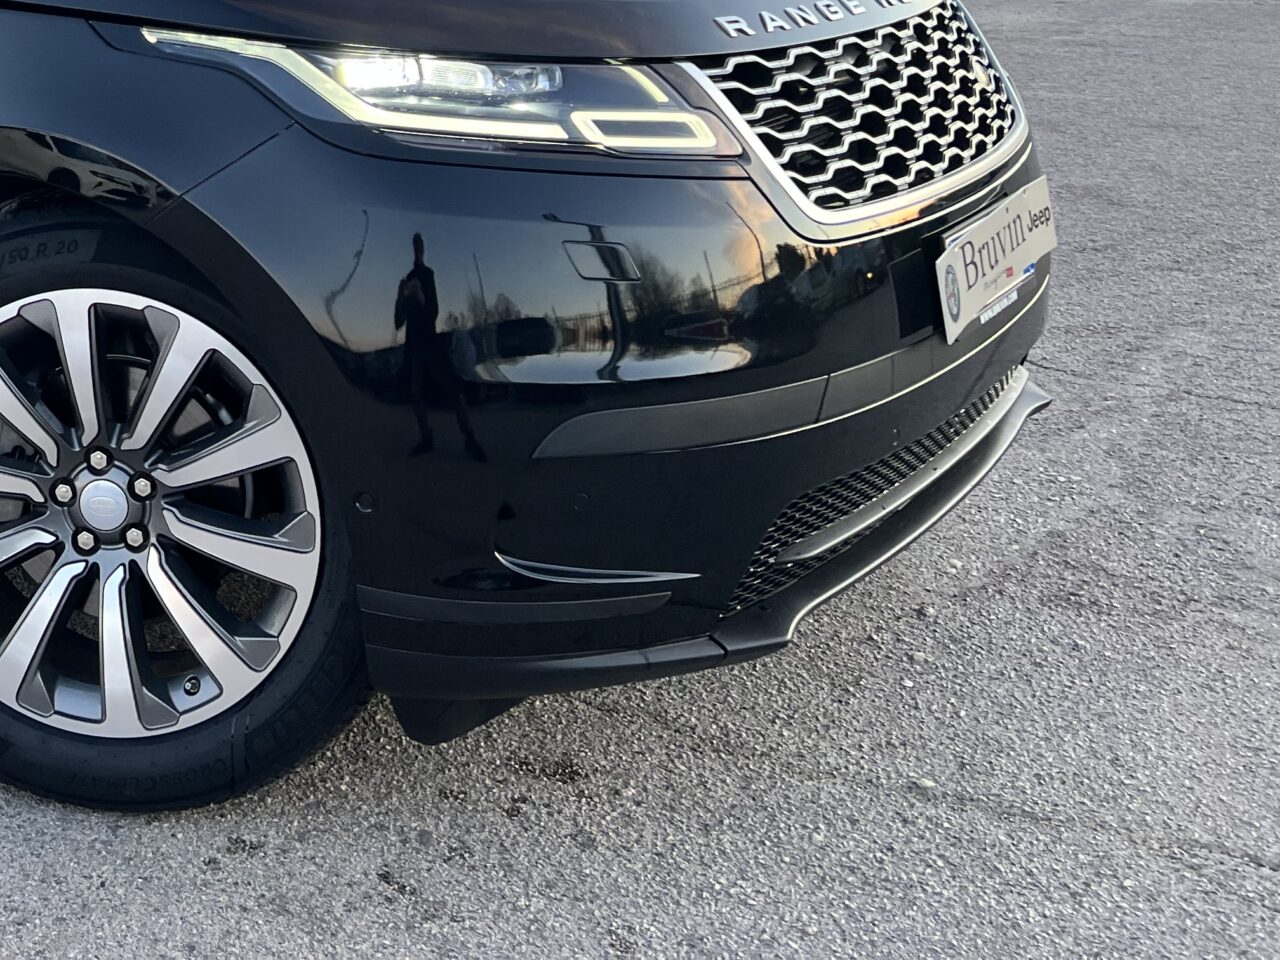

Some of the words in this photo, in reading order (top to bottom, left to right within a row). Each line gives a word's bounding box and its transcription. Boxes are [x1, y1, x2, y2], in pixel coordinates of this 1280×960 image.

[35, 243, 49, 257] R
[55, 239, 79, 255] 20
[960, 207, 1027, 291] Bruvin
[1026, 206, 1051, 233] Jeep
